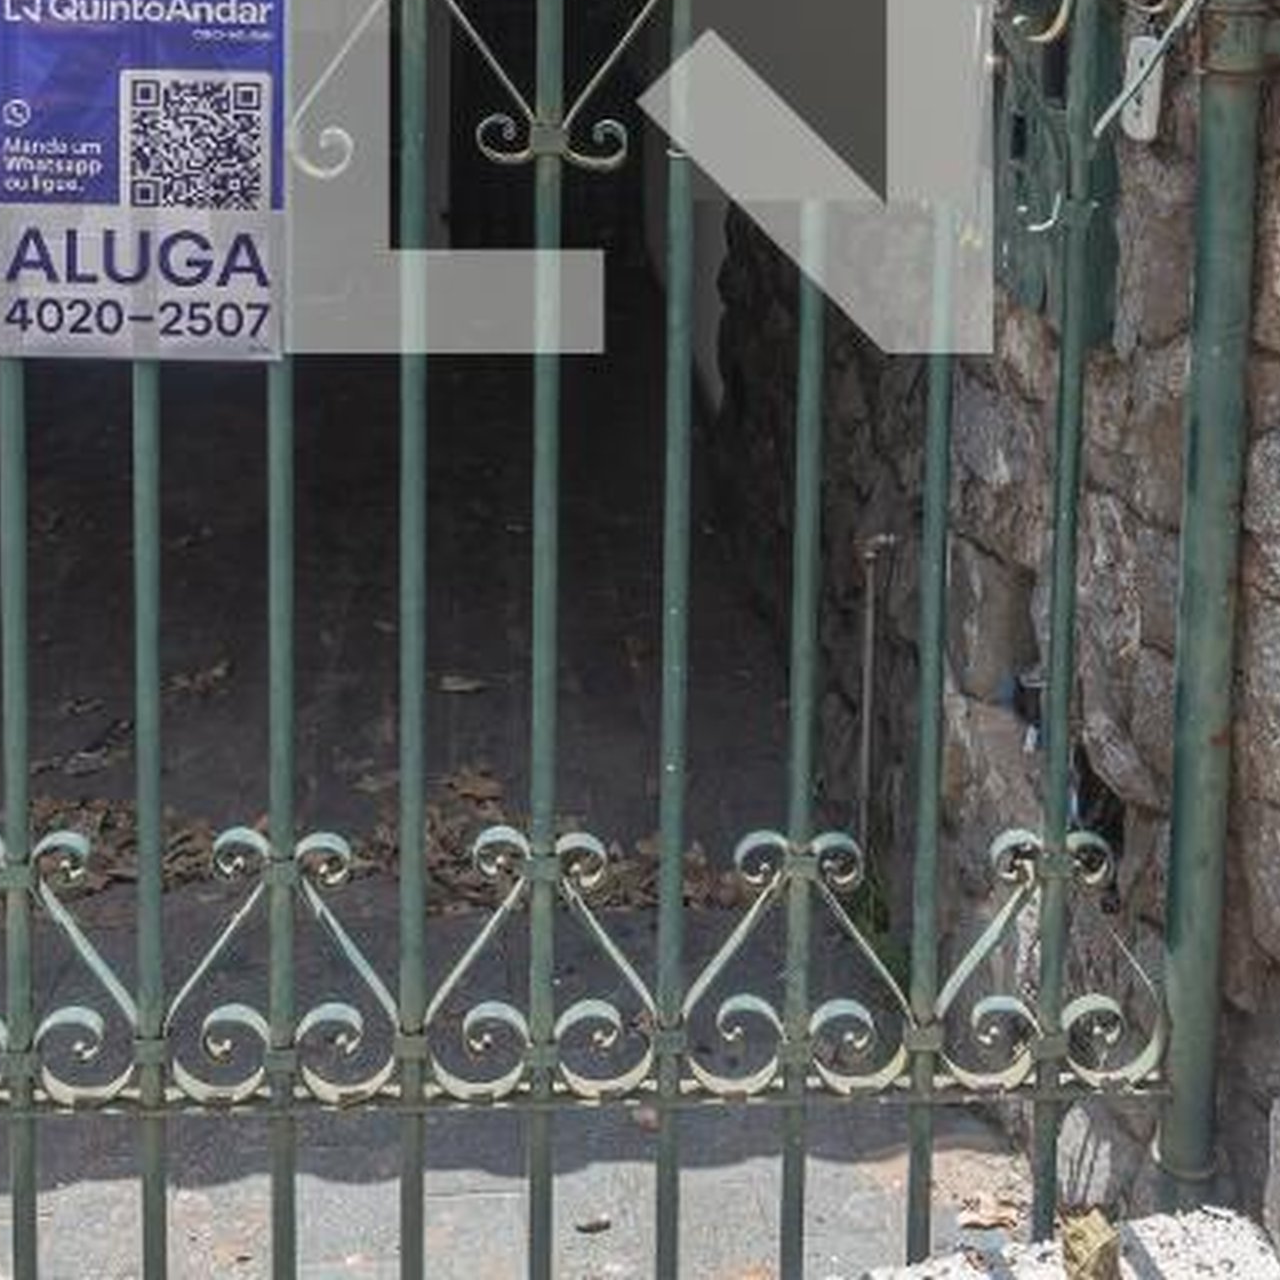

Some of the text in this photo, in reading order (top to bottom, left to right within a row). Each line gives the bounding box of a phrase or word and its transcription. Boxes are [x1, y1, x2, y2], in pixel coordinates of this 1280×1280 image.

[70, 142, 102, 155] um
[4, 179, 29, 192] ou
[5, 226, 270, 287] ALUGA
[4, 297, 271, 337] 4020-2507
